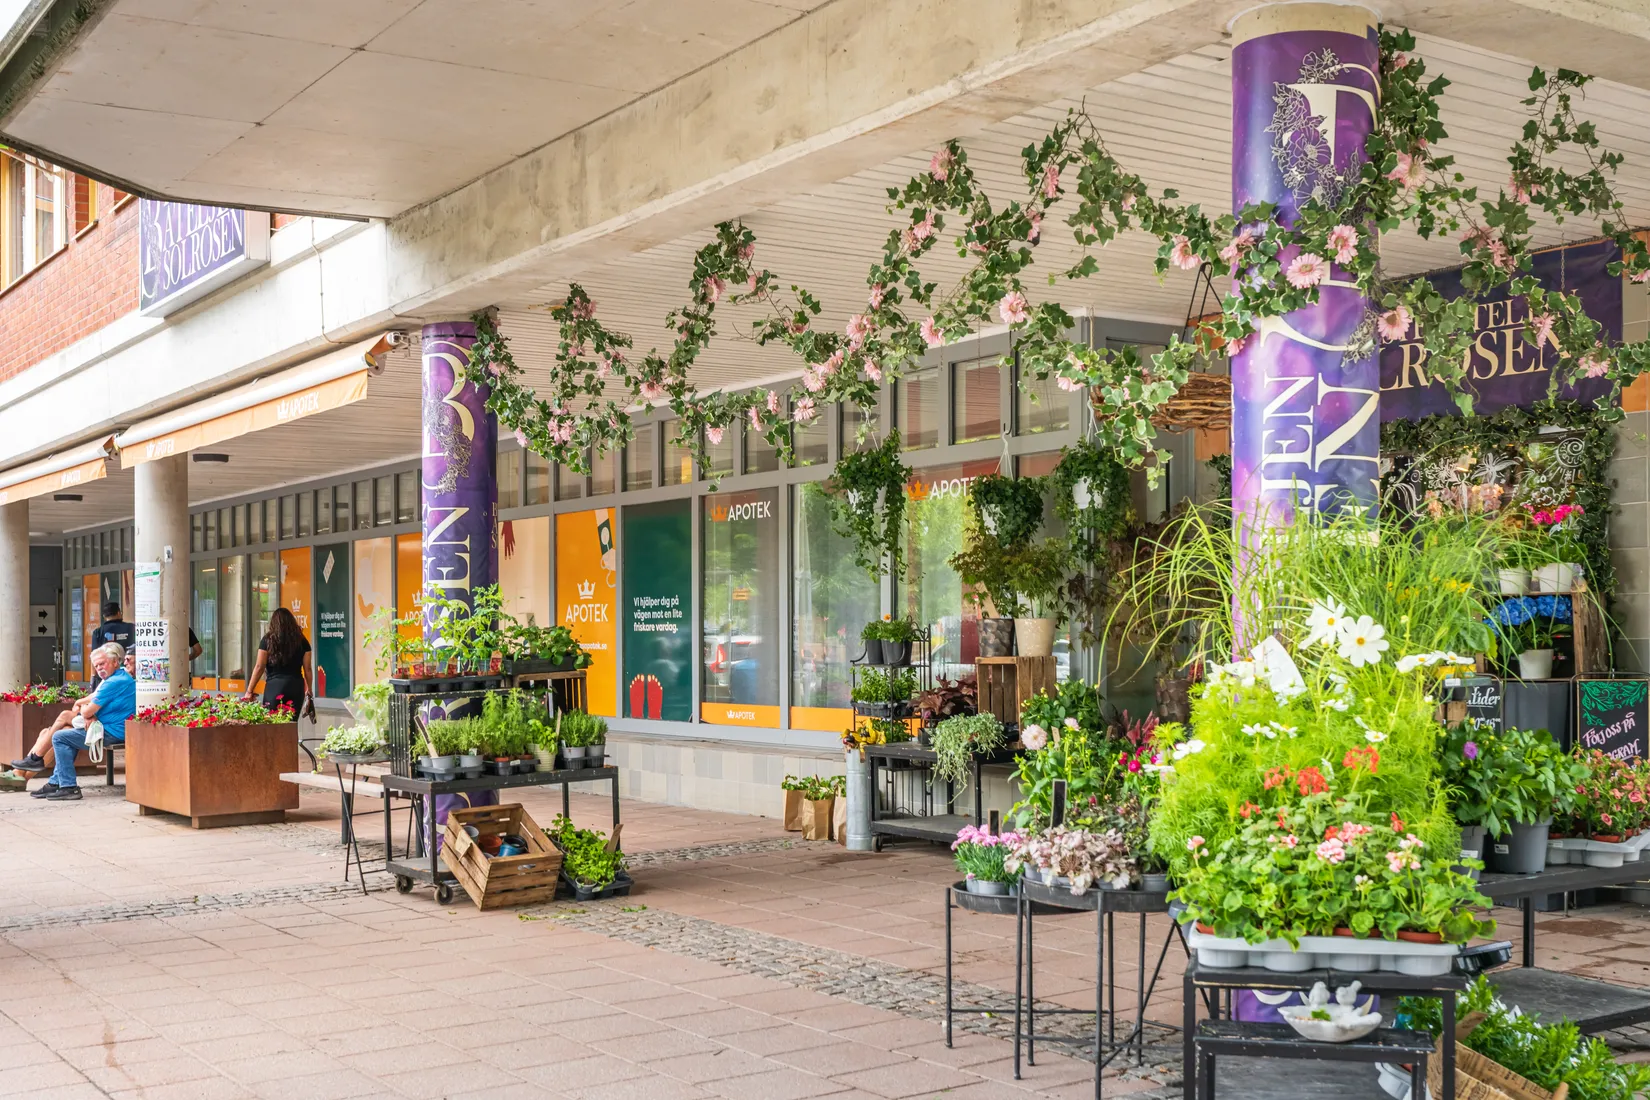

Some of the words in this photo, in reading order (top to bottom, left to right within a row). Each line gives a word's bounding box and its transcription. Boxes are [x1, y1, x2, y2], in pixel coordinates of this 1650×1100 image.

[163, 208, 243, 290] SOLROSEN
[288, 391, 320, 420] APOTEK
[728, 501, 771, 521] APOTEK
[633, 597, 640, 607] Vi
[640, 597, 660, 609] hjälper
[661, 596, 671, 608] dig
[671, 594, 680, 608] på
[565, 603, 609, 623] APOTEK
[633, 609, 652, 621] vägen
[652, 610, 663, 619] mot
[664, 611, 672, 619] en
[672, 608, 683, 619] lite
[633, 622, 655, 632] friskare
[656, 622, 679, 634] vardag.
[136, 639, 165, 647] GELBY
[735, 711, 756, 720] APOTEK
